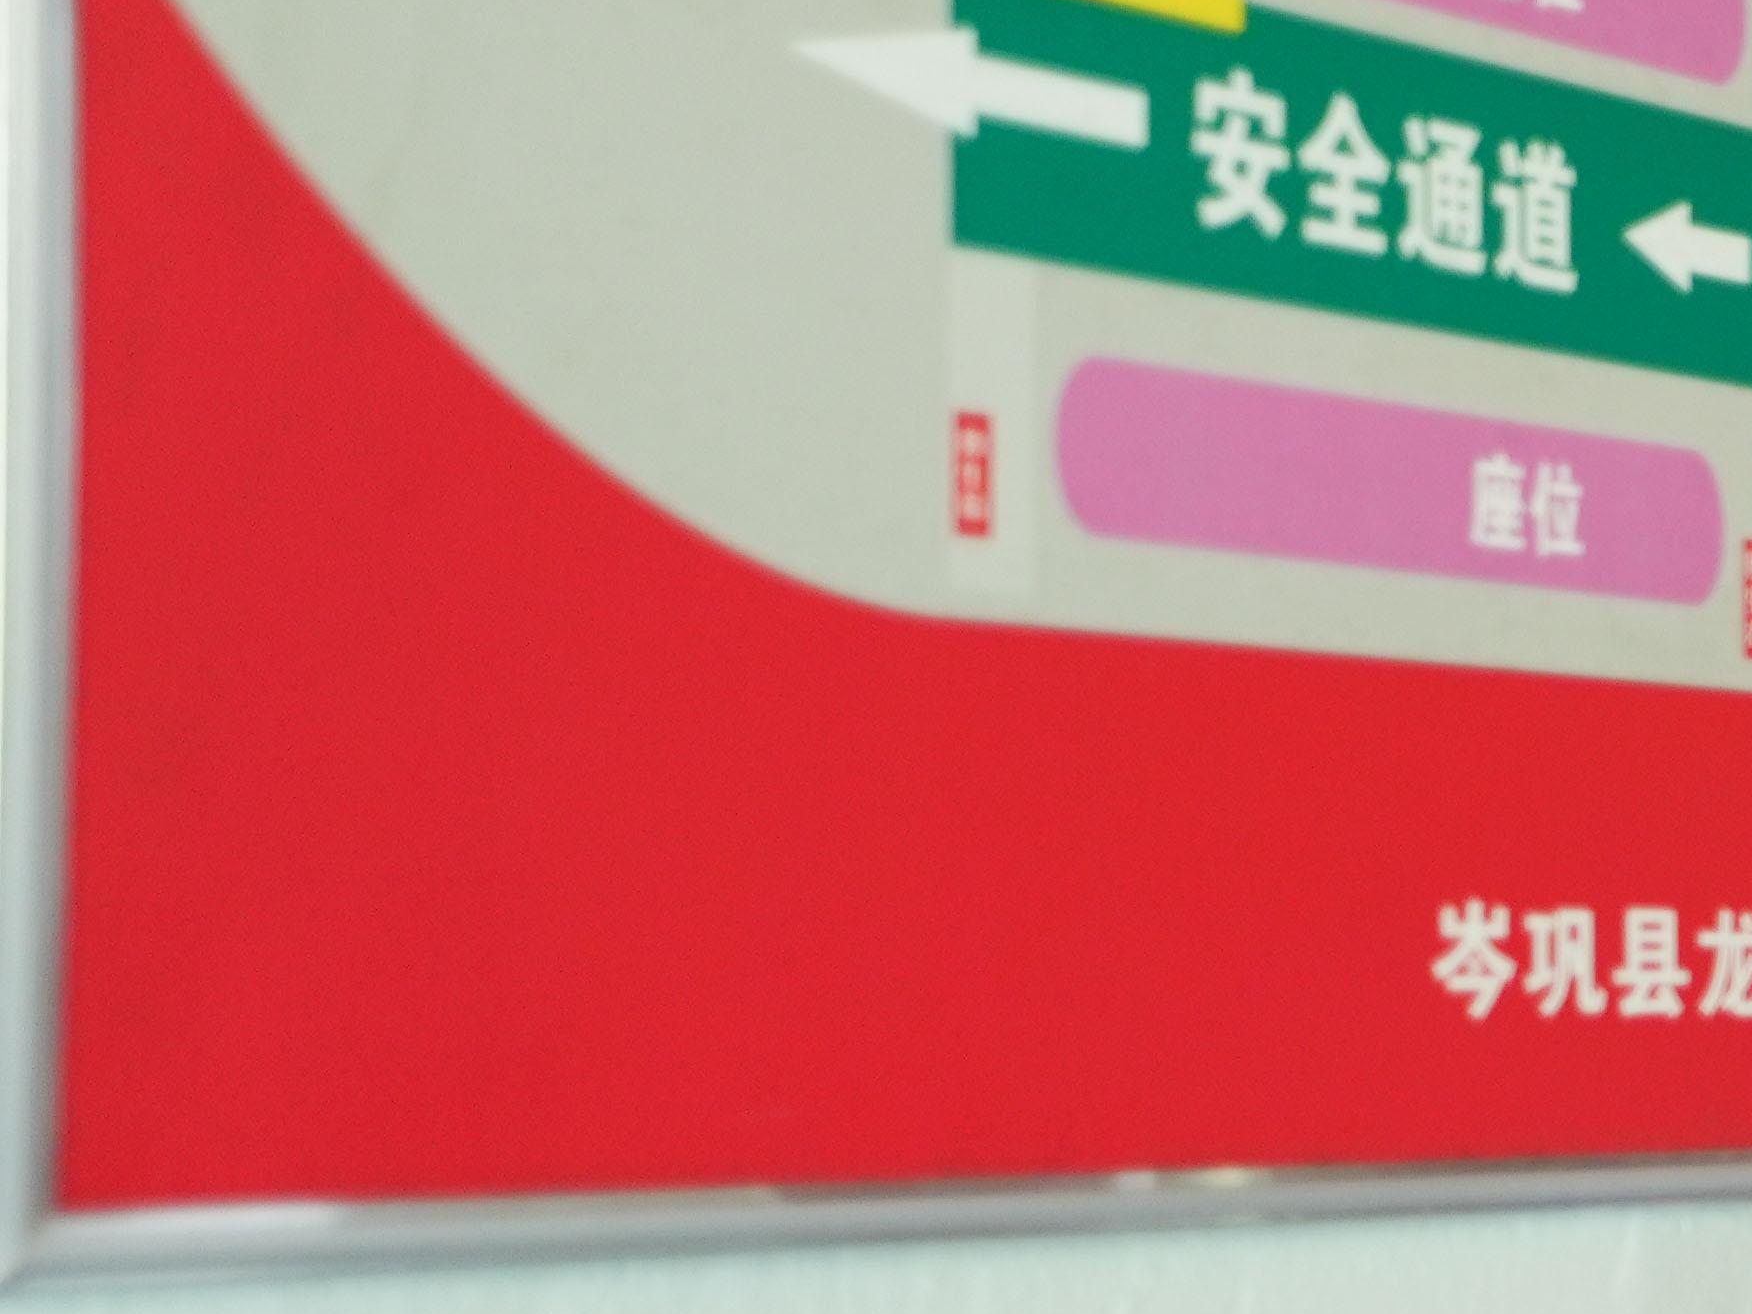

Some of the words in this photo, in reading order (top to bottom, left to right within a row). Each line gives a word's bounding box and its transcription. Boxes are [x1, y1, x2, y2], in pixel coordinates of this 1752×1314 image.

[1190, 65, 1579, 294] 安全通道
[1468, 452, 1586, 558] 座位
